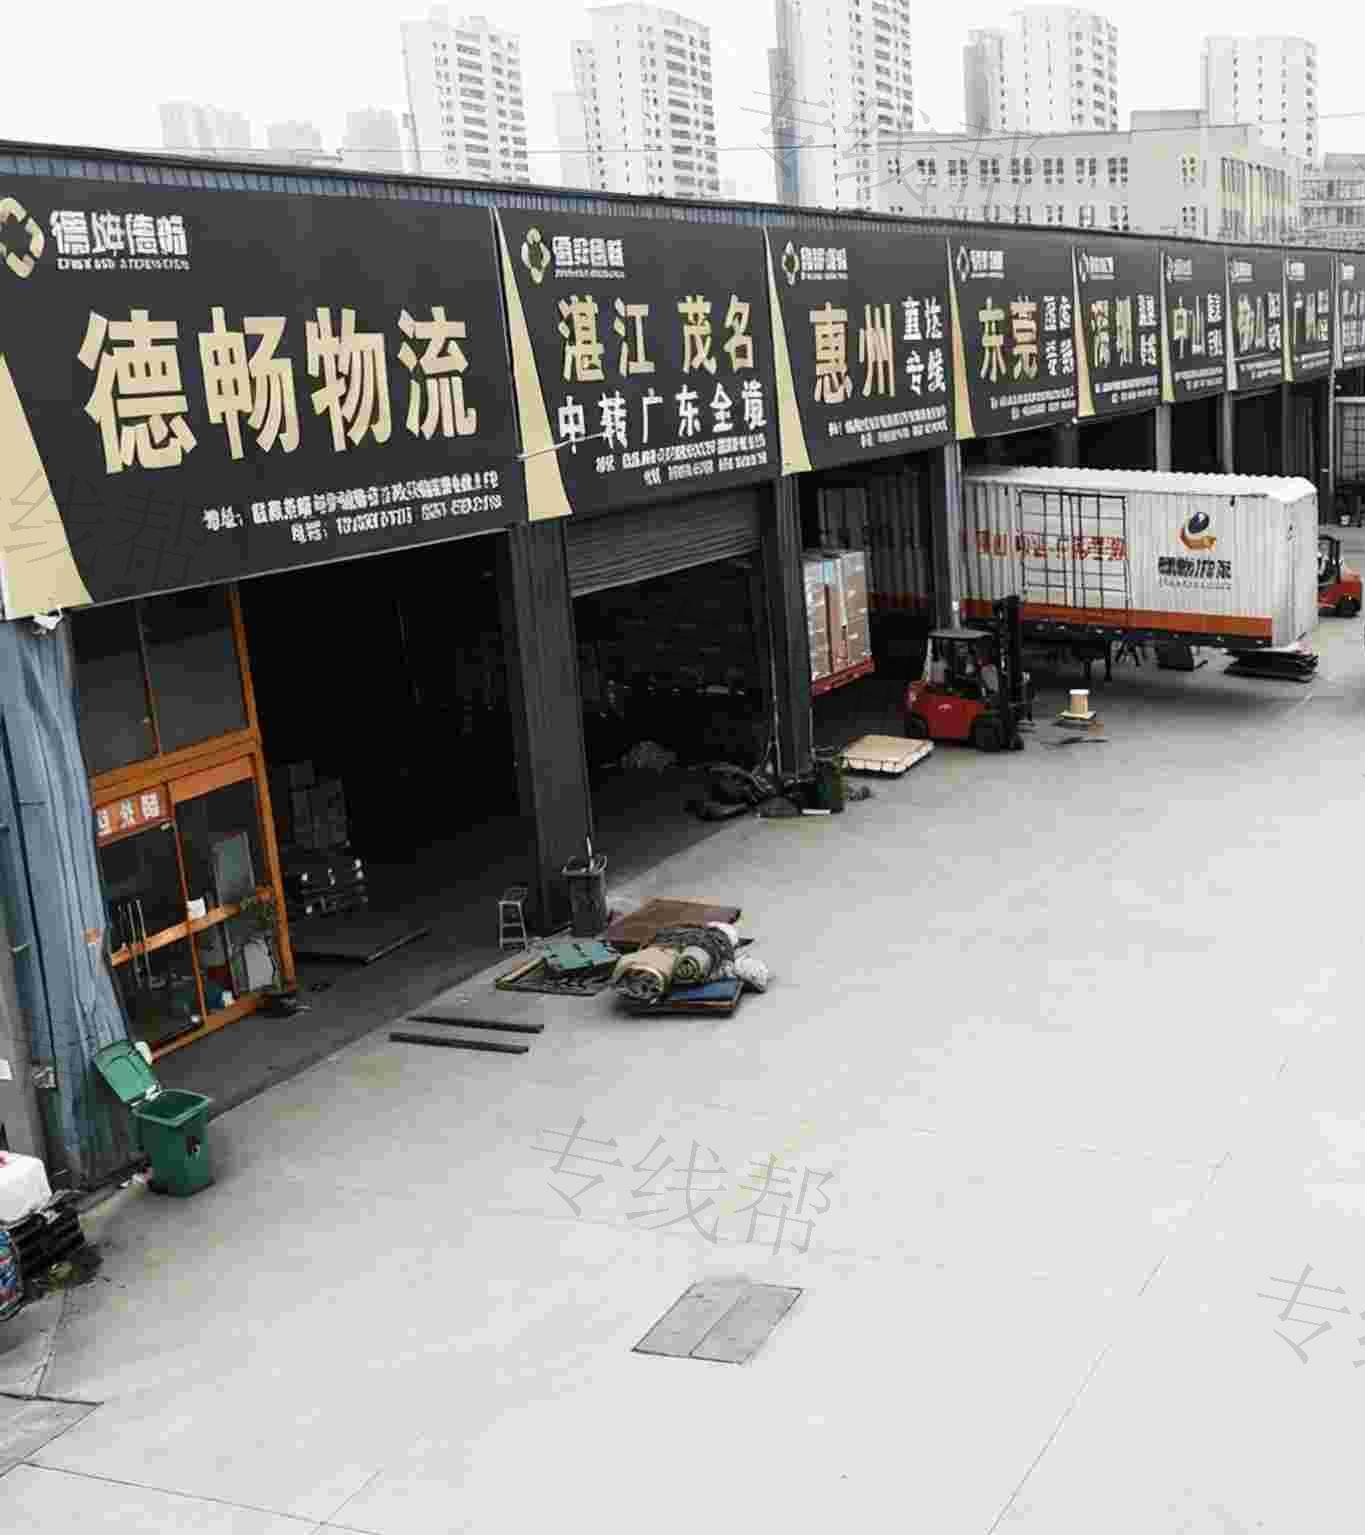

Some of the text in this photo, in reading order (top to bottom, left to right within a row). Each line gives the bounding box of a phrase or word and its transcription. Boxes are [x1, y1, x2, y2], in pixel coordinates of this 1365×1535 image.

[78, 305, 478, 474] 德畅物流
[558, 294, 755, 382] 湛江 茂名
[809, 301, 896, 404] 惠州
